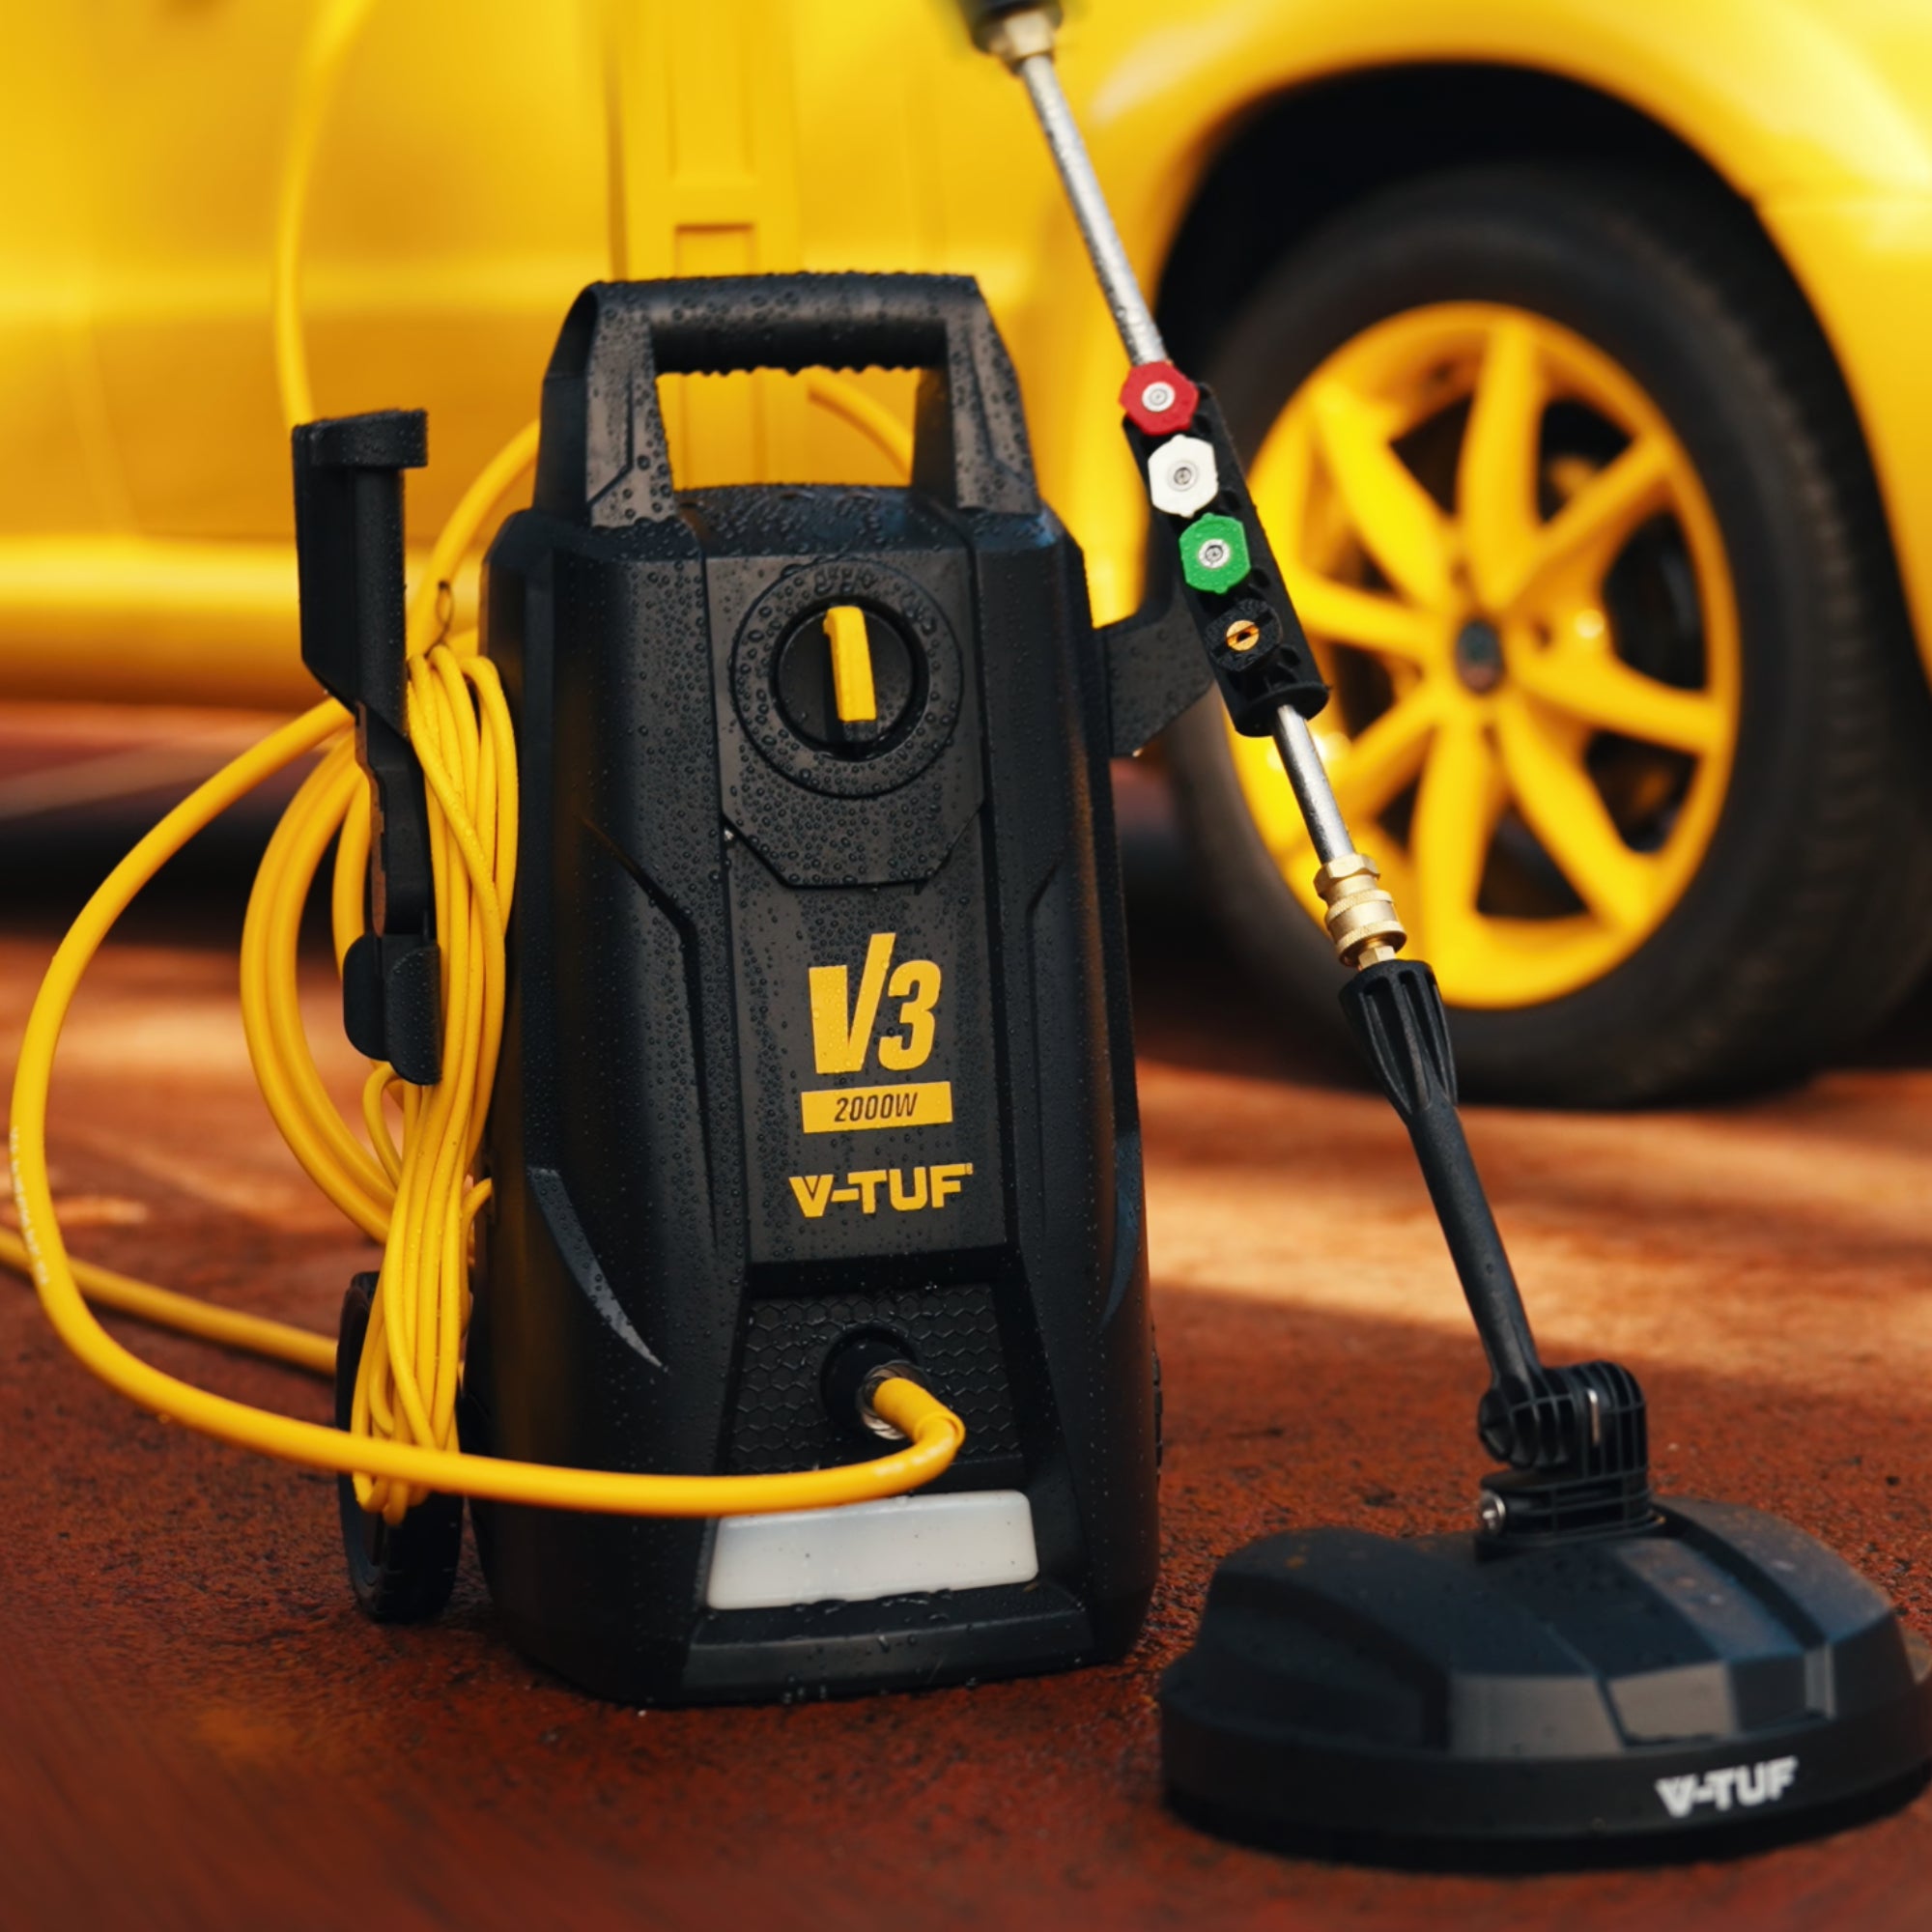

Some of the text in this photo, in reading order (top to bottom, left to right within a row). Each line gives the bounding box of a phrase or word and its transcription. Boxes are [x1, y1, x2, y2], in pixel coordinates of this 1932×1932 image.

[809, 932, 942, 1074] V3
[834, 1093, 919, 1122] 2000W
[788, 1163, 973, 1218] V-TUF
[1655, 1754, 1799, 1818] V-TUF
